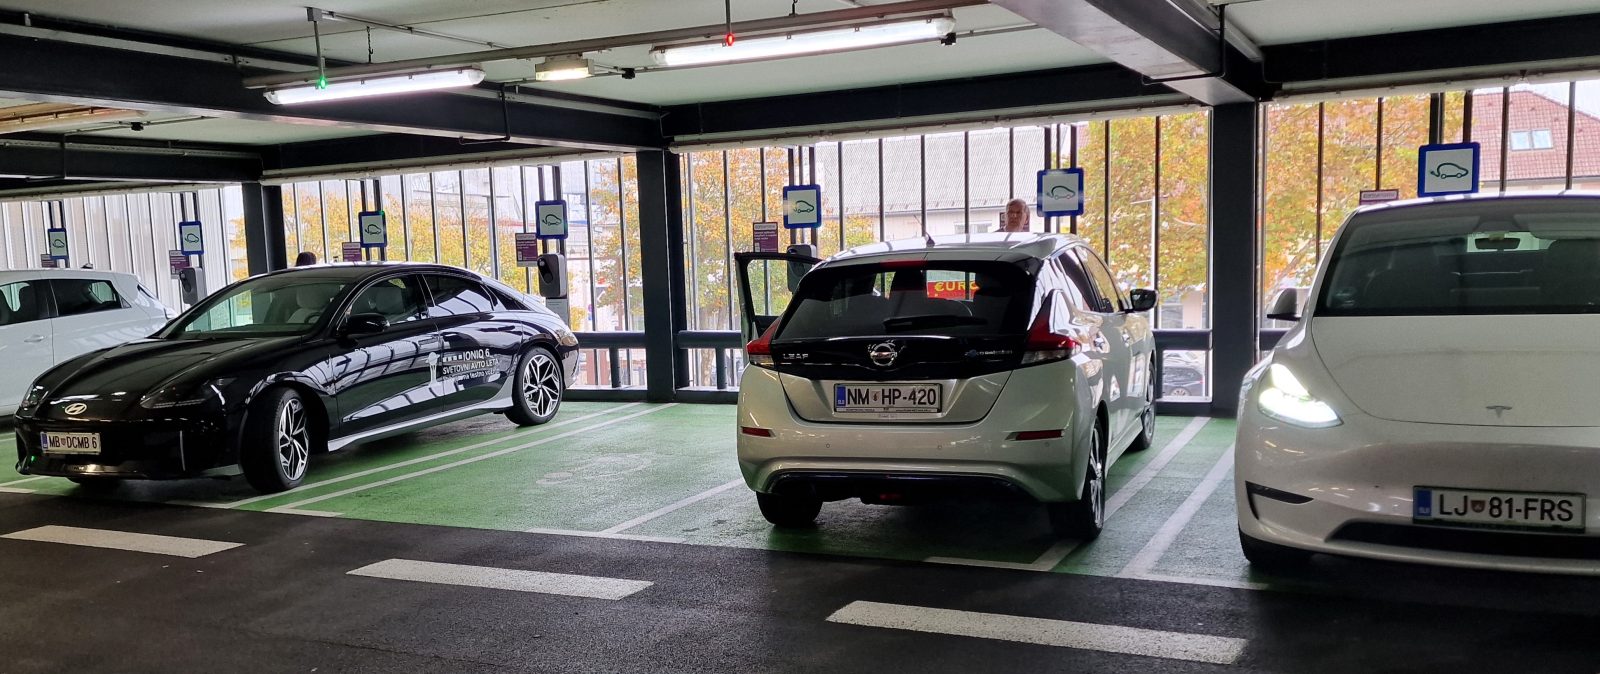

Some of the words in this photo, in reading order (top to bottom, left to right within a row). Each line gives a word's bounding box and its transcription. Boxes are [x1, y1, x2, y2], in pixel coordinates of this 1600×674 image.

[463, 349, 484, 361] IONIQ
[485, 348, 490, 357] 6
[443, 364, 471, 375] SVETOVNI
[471, 360, 486, 370] AVTO
[486, 358, 499, 367] LETA
[847, 388, 870, 405] NM
[881, 388, 937, 406] HP-420
[49, 436, 61, 448] MB
[66, 436, 90, 449] DCMB
[92, 437, 98, 449] 6
[1439, 494, 1469, 517] LJ
[1488, 496, 1574, 522] 81-FRS
